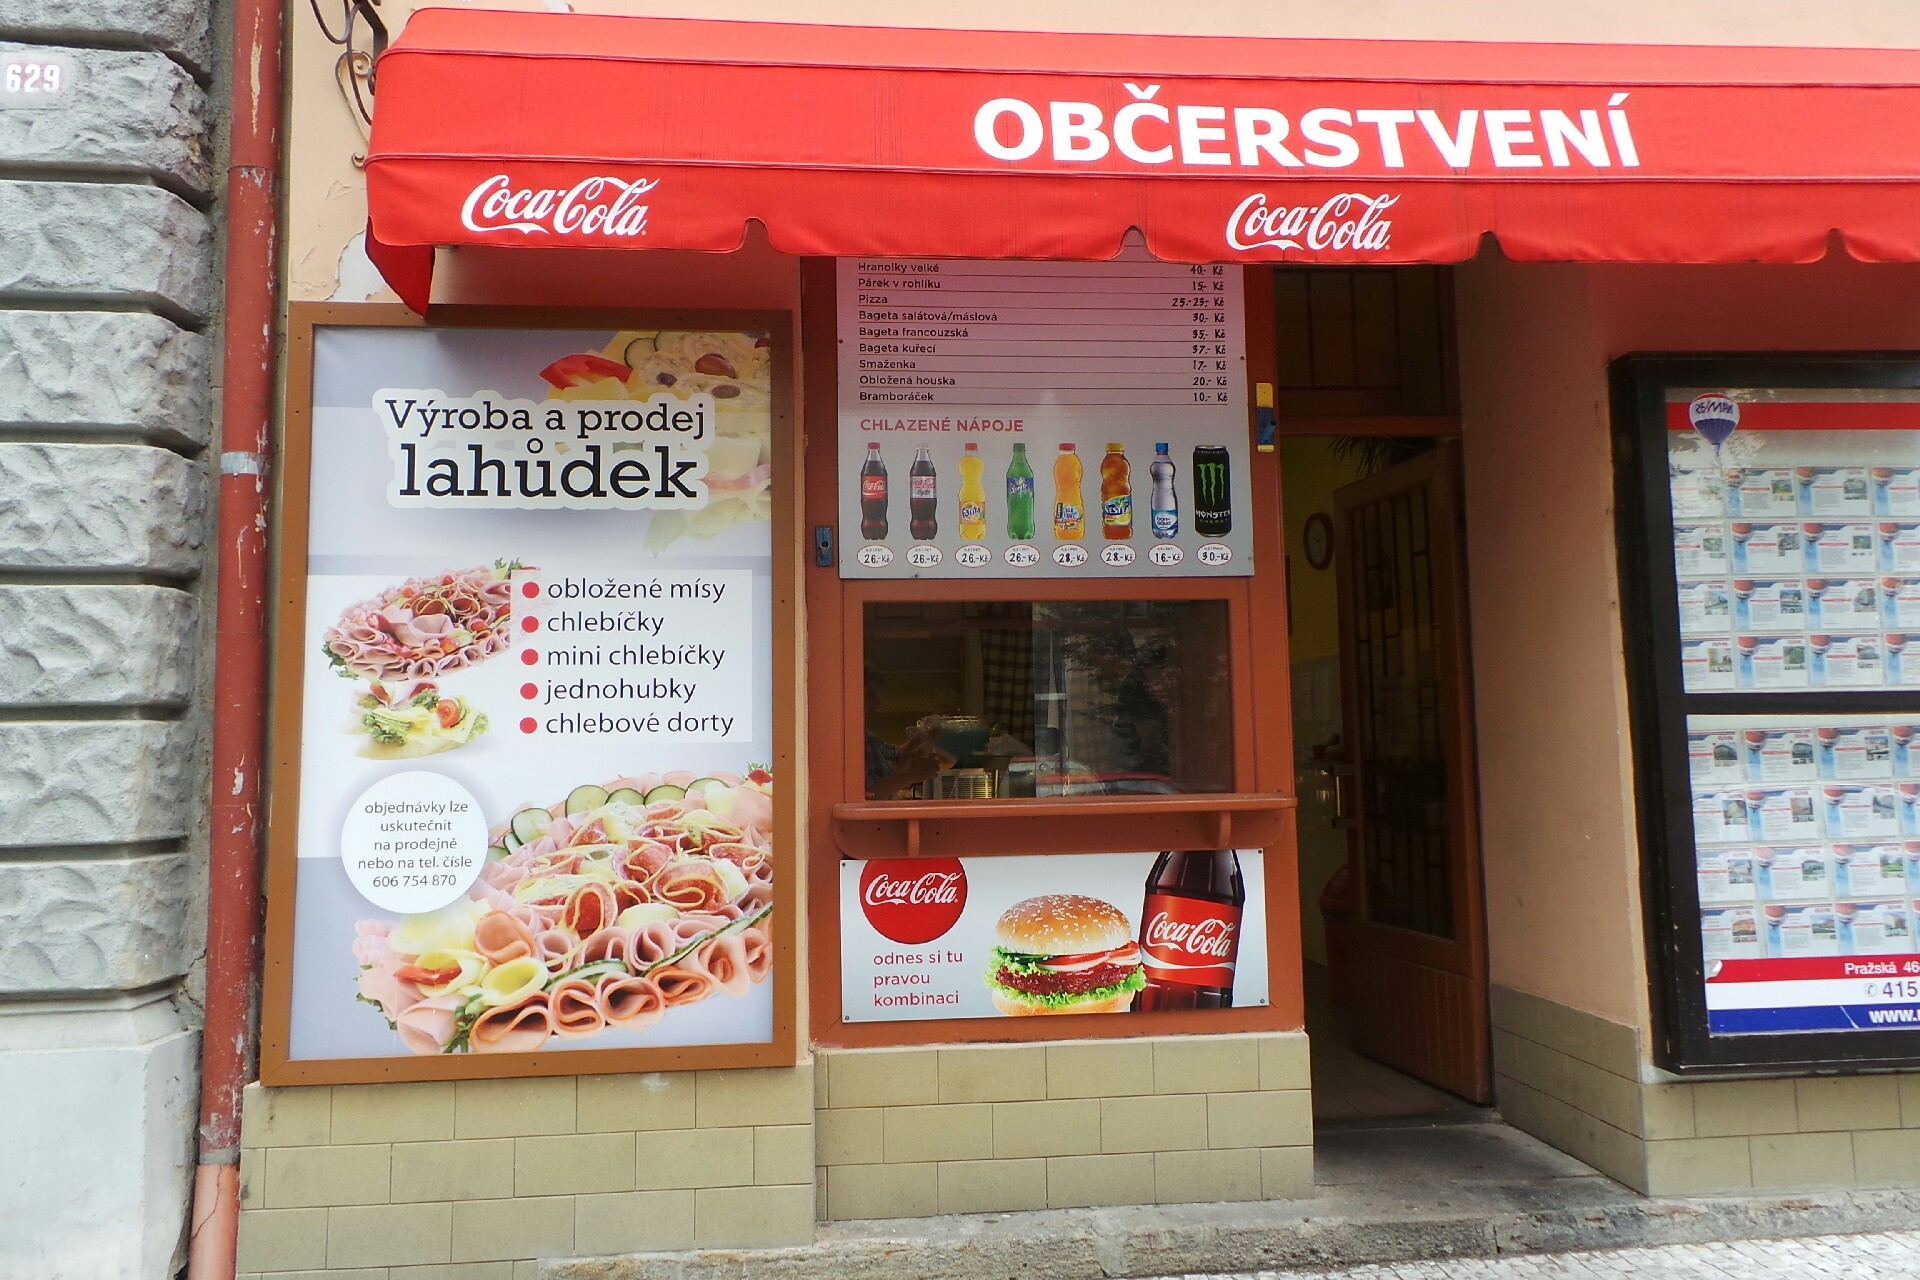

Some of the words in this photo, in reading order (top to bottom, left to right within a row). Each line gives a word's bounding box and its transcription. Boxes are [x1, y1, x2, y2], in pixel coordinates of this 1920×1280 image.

[6, 64, 60, 93] 629
[973, 83, 1641, 170] OBČERSTVENÍ
[461, 174, 661, 237] Coca-Cola
[1226, 192, 1402, 252] Coca-Cola
[858, 262, 907, 273] Hranolky
[911, 263, 940, 273] velké
[1213, 265, 1224, 275] Kč
[858, 278, 890, 288] Párek
[902, 279, 941, 289] rohlíku
[1213, 281, 1224, 291] Kč
[858, 295, 888, 304] Pizza
[1214, 297, 1225, 307] Kč
[859, 311, 899, 322] Bageta
[902, 311, 998, 322] salátová/máslová
[1214, 313, 1225, 323] Kč
[859, 327, 899, 338] Bageta
[902, 327, 969, 338] francouzská
[1215, 329, 1226, 339] Kč
[859, 343, 899, 354] Bageta
[902, 343, 936, 353] kuřecí
[1215, 345, 1226, 355] Kč
[859, 360, 916, 369] Smaženka
[1216, 360, 1226, 370] Kč
[859, 375, 913, 385] Obložená
[916, 376, 956, 386] houska
[1217, 376, 1227, 386] Kč
[859, 391, 934, 401] Bramboráček
[1217, 392, 1228, 402] Kč
[385, 399, 533, 437] Výroba
[545, 408, 567, 431] a
[577, 402, 706, 440] prodej
[860, 416, 951, 431] CHLAZENÉ
[956, 416, 1024, 432] NÁPOJE
[398, 437, 698, 500] lahůdek
[547, 577, 662, 599] obložené
[670, 579, 726, 604] mísy
[547, 611, 665, 637] chlebíčky
[547, 645, 601, 667] mini
[608, 643, 725, 670] chlebíčky
[544, 678, 697, 705] jednohubky
[545, 711, 660, 735] chlebové
[667, 711, 735, 738] dorty
[364, 800, 446, 816] objednávky
[449, 800, 469, 813] lze
[380, 819, 453, 832] uskutečnit
[374, 841, 391, 850] na
[395, 837, 458, 853] prodejně
[358, 857, 394, 869] nebo
[398, 859, 415, 869] na
[419, 856, 440, 868] tel.
[443, 855, 472, 868] čísle
[373, 876, 399, 888] 606
[403, 875, 429, 887] 754
[432, 874, 457, 886] 870
[865, 872, 962, 906] Coca-Cola
[1146, 911, 1236, 957] Coca-Cola
[873, 952, 923, 965] odnes
[929, 950, 941, 963] si
[947, 950, 963, 963] tu
[1844, 961, 1898, 975] Pražská
[1903, 961, 1920, 973] 46
[874, 974, 930, 988] pravou
[1882, 981, 1918, 998] 415
[874, 990, 959, 1006] kombinaci
